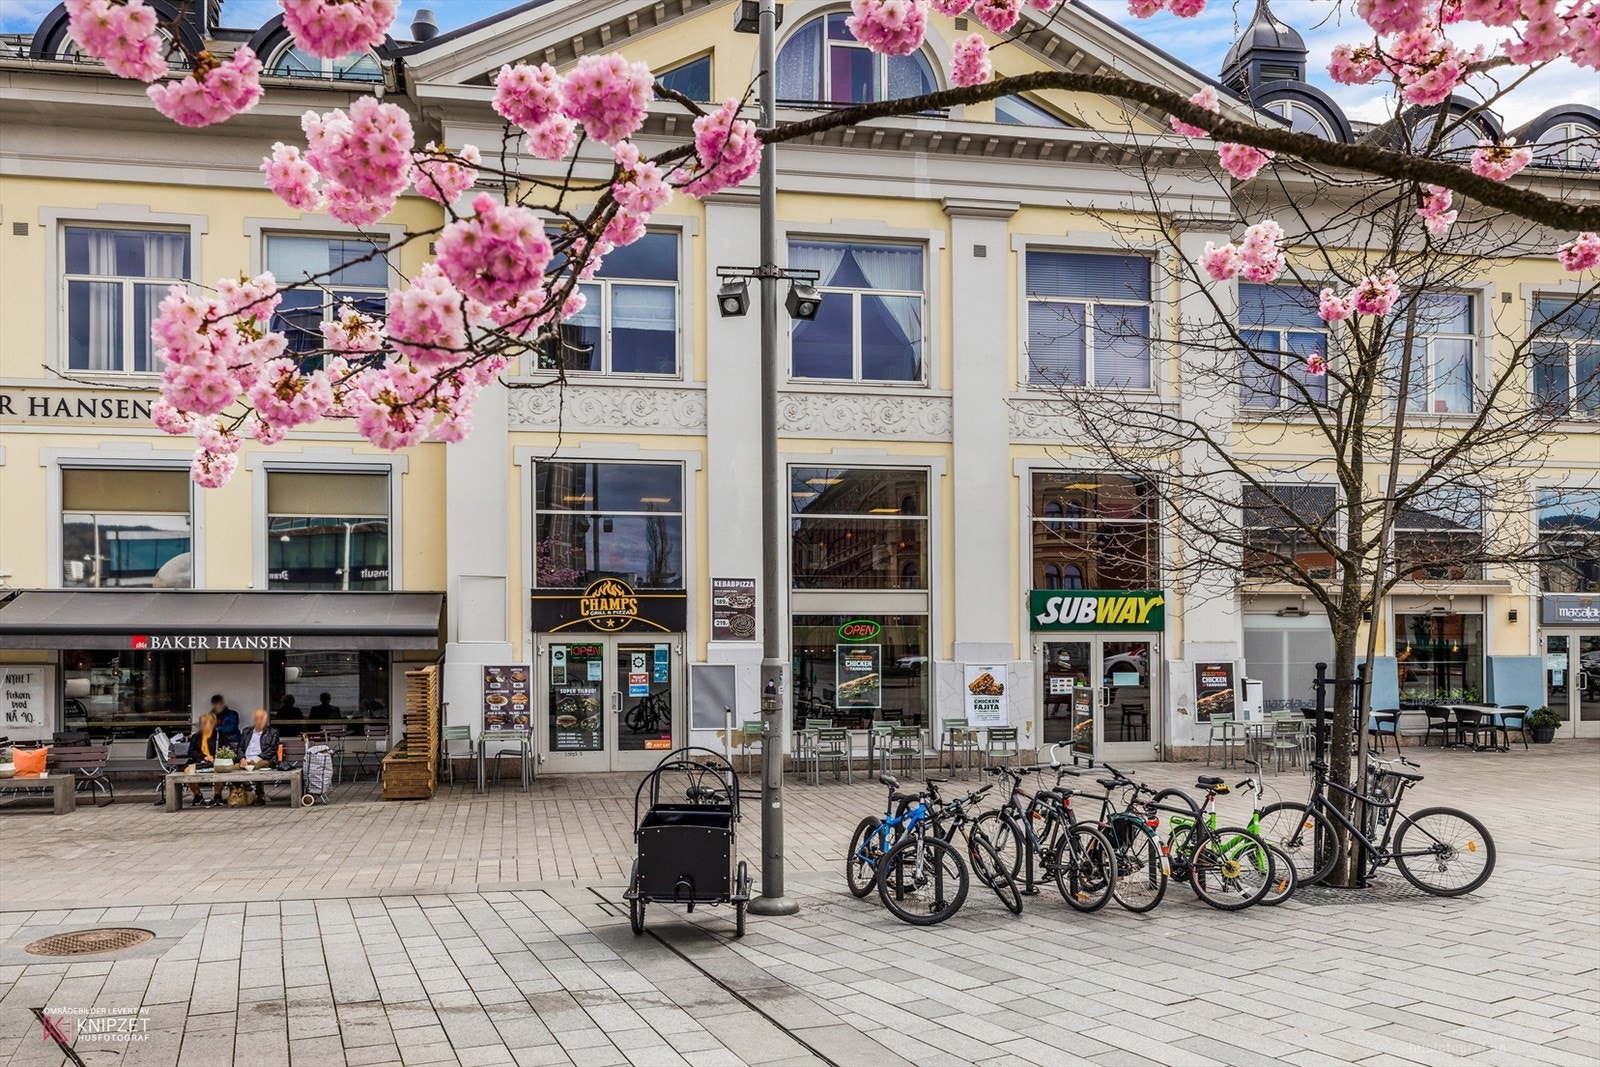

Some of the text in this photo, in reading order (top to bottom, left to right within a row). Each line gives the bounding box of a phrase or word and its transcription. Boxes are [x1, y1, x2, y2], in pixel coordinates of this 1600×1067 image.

[28, 396, 153, 419] HANSEN
[580, 598, 638, 616] CHAMPS
[1036, 595, 1165, 625] SUBWAY
[843, 624, 875, 636] OPEN
[151, 636, 210, 649] BAKER
[217, 635, 292, 649] HANSEN
[572, 645, 600, 656] OPEN
[6, 673, 33, 685] NYHET
[6, 709, 18, 722] NÅ
